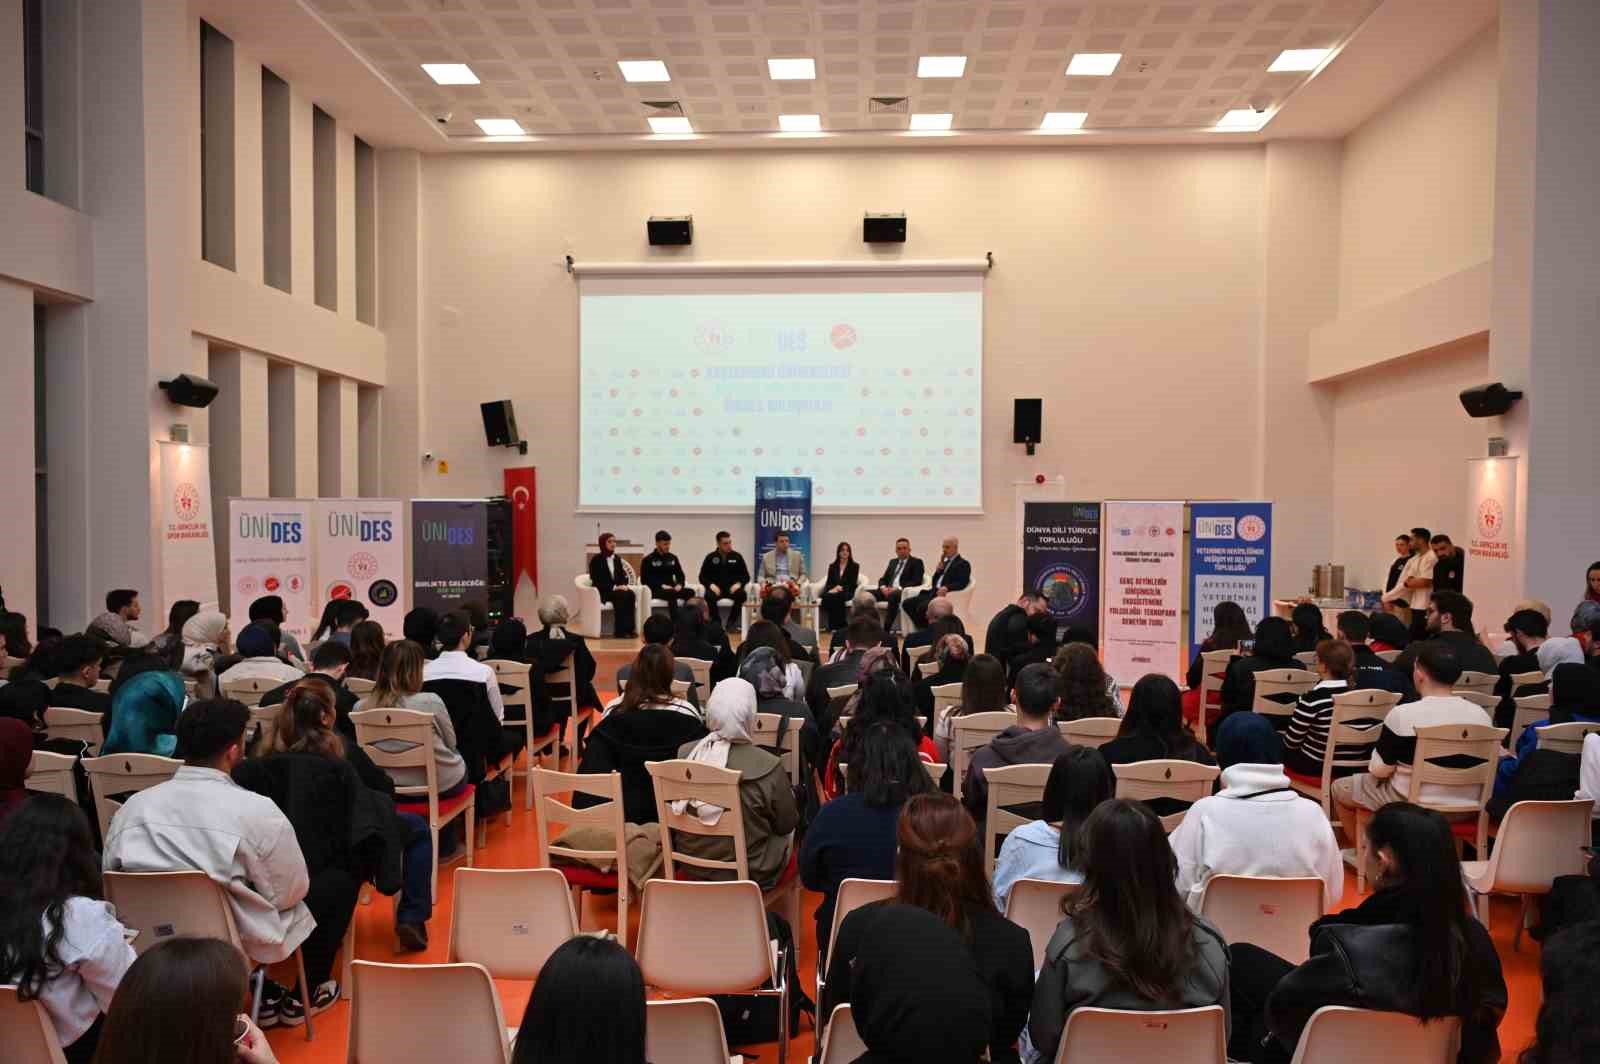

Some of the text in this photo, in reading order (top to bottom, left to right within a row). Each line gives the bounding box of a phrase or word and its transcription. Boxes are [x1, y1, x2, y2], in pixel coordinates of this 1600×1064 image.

[239, 512, 302, 543] ÜNİDES
[328, 511, 392, 542] ÜNİDES
[761, 506, 803, 532] ÜNİDES
[1026, 525, 1098, 535] DÜNYA DİLİ TÜRKÇE
[1039, 535, 1084, 544] TOPLULUĞU
